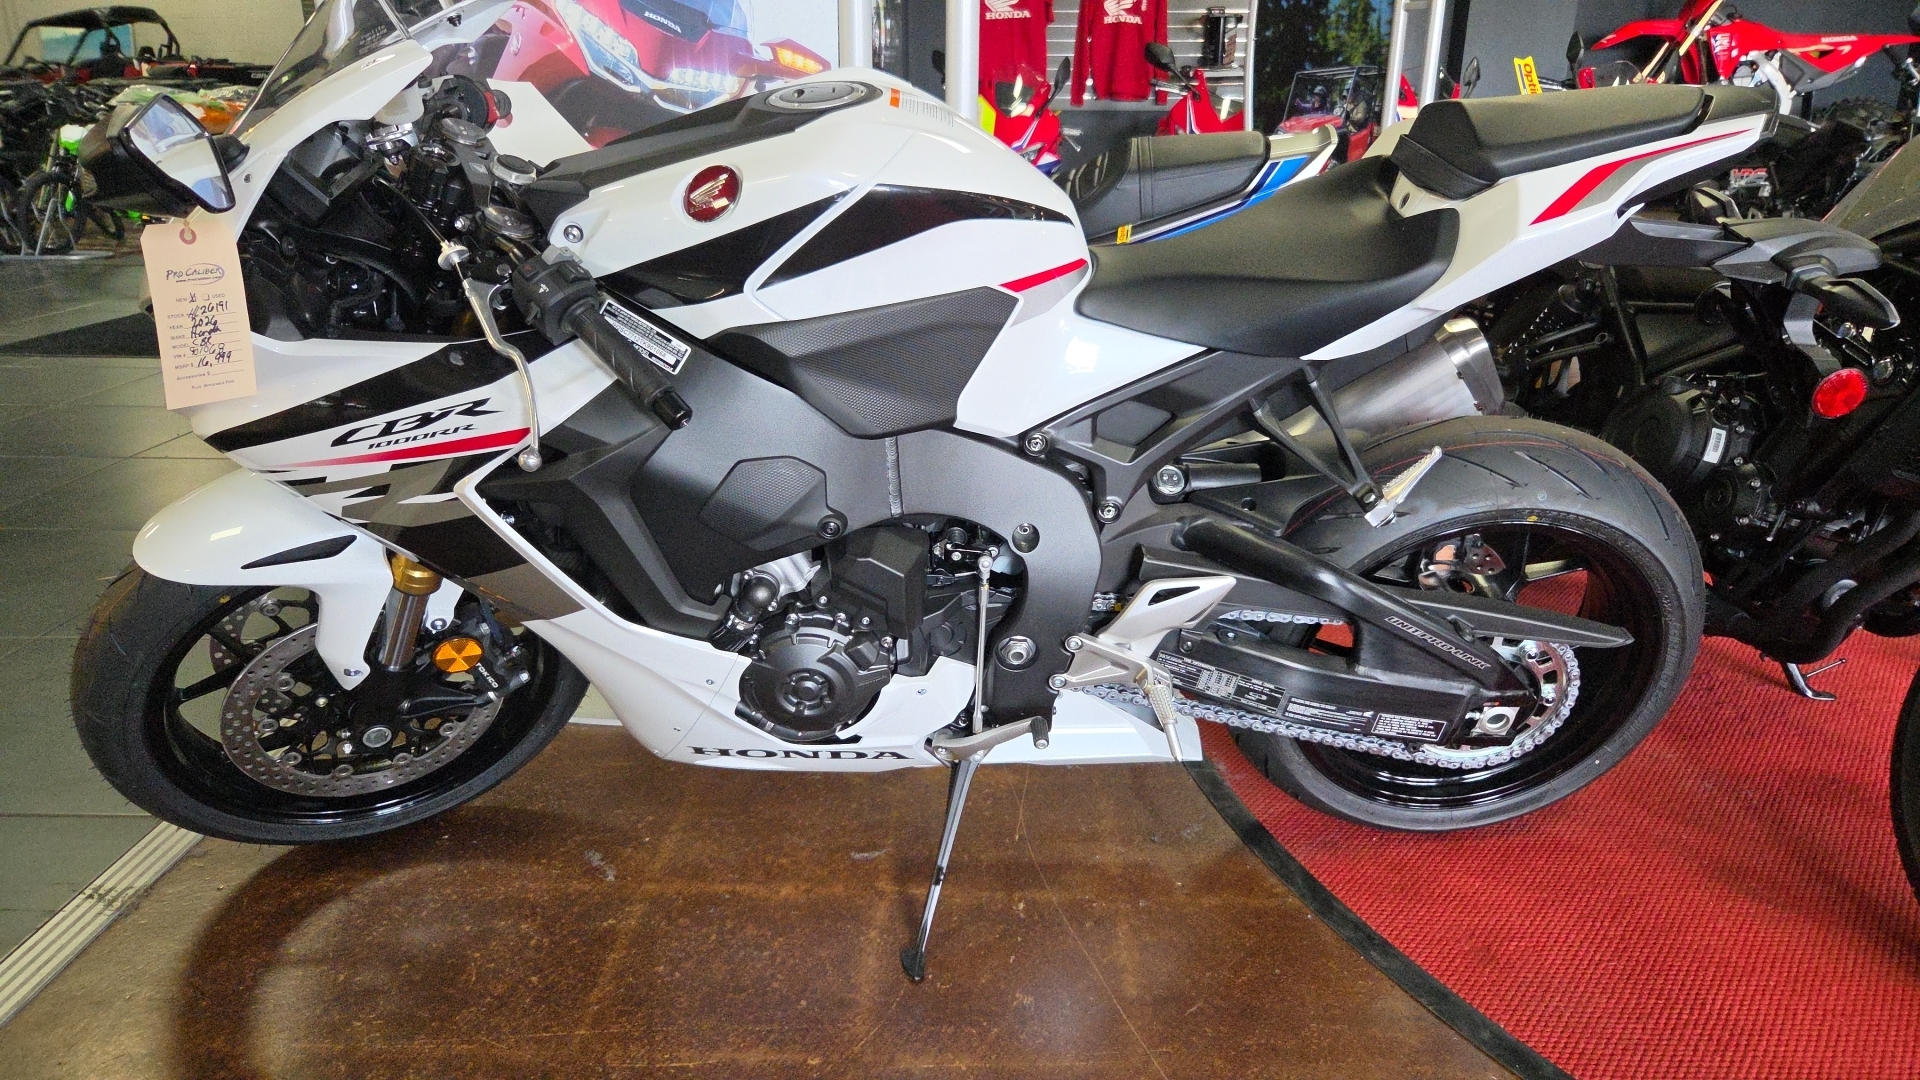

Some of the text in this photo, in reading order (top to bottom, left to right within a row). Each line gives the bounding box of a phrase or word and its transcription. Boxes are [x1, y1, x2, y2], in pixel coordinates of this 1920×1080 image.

[644, 11, 681, 33] HONDA
[985, 11, 1031, 20] HONDA
[1104, 15, 1142, 25] HONDA
[1821, 35, 1858, 43] HONDA
[166, 267, 222, 280] PRO CALIBER
[330, 397, 505, 447] CBR
[367, 424, 479, 450] 1000RR
[1384, 615, 1422, 638] UNIT
[476, 662, 499, 689] TOKICO
[687, 746, 915, 760] HONDA
